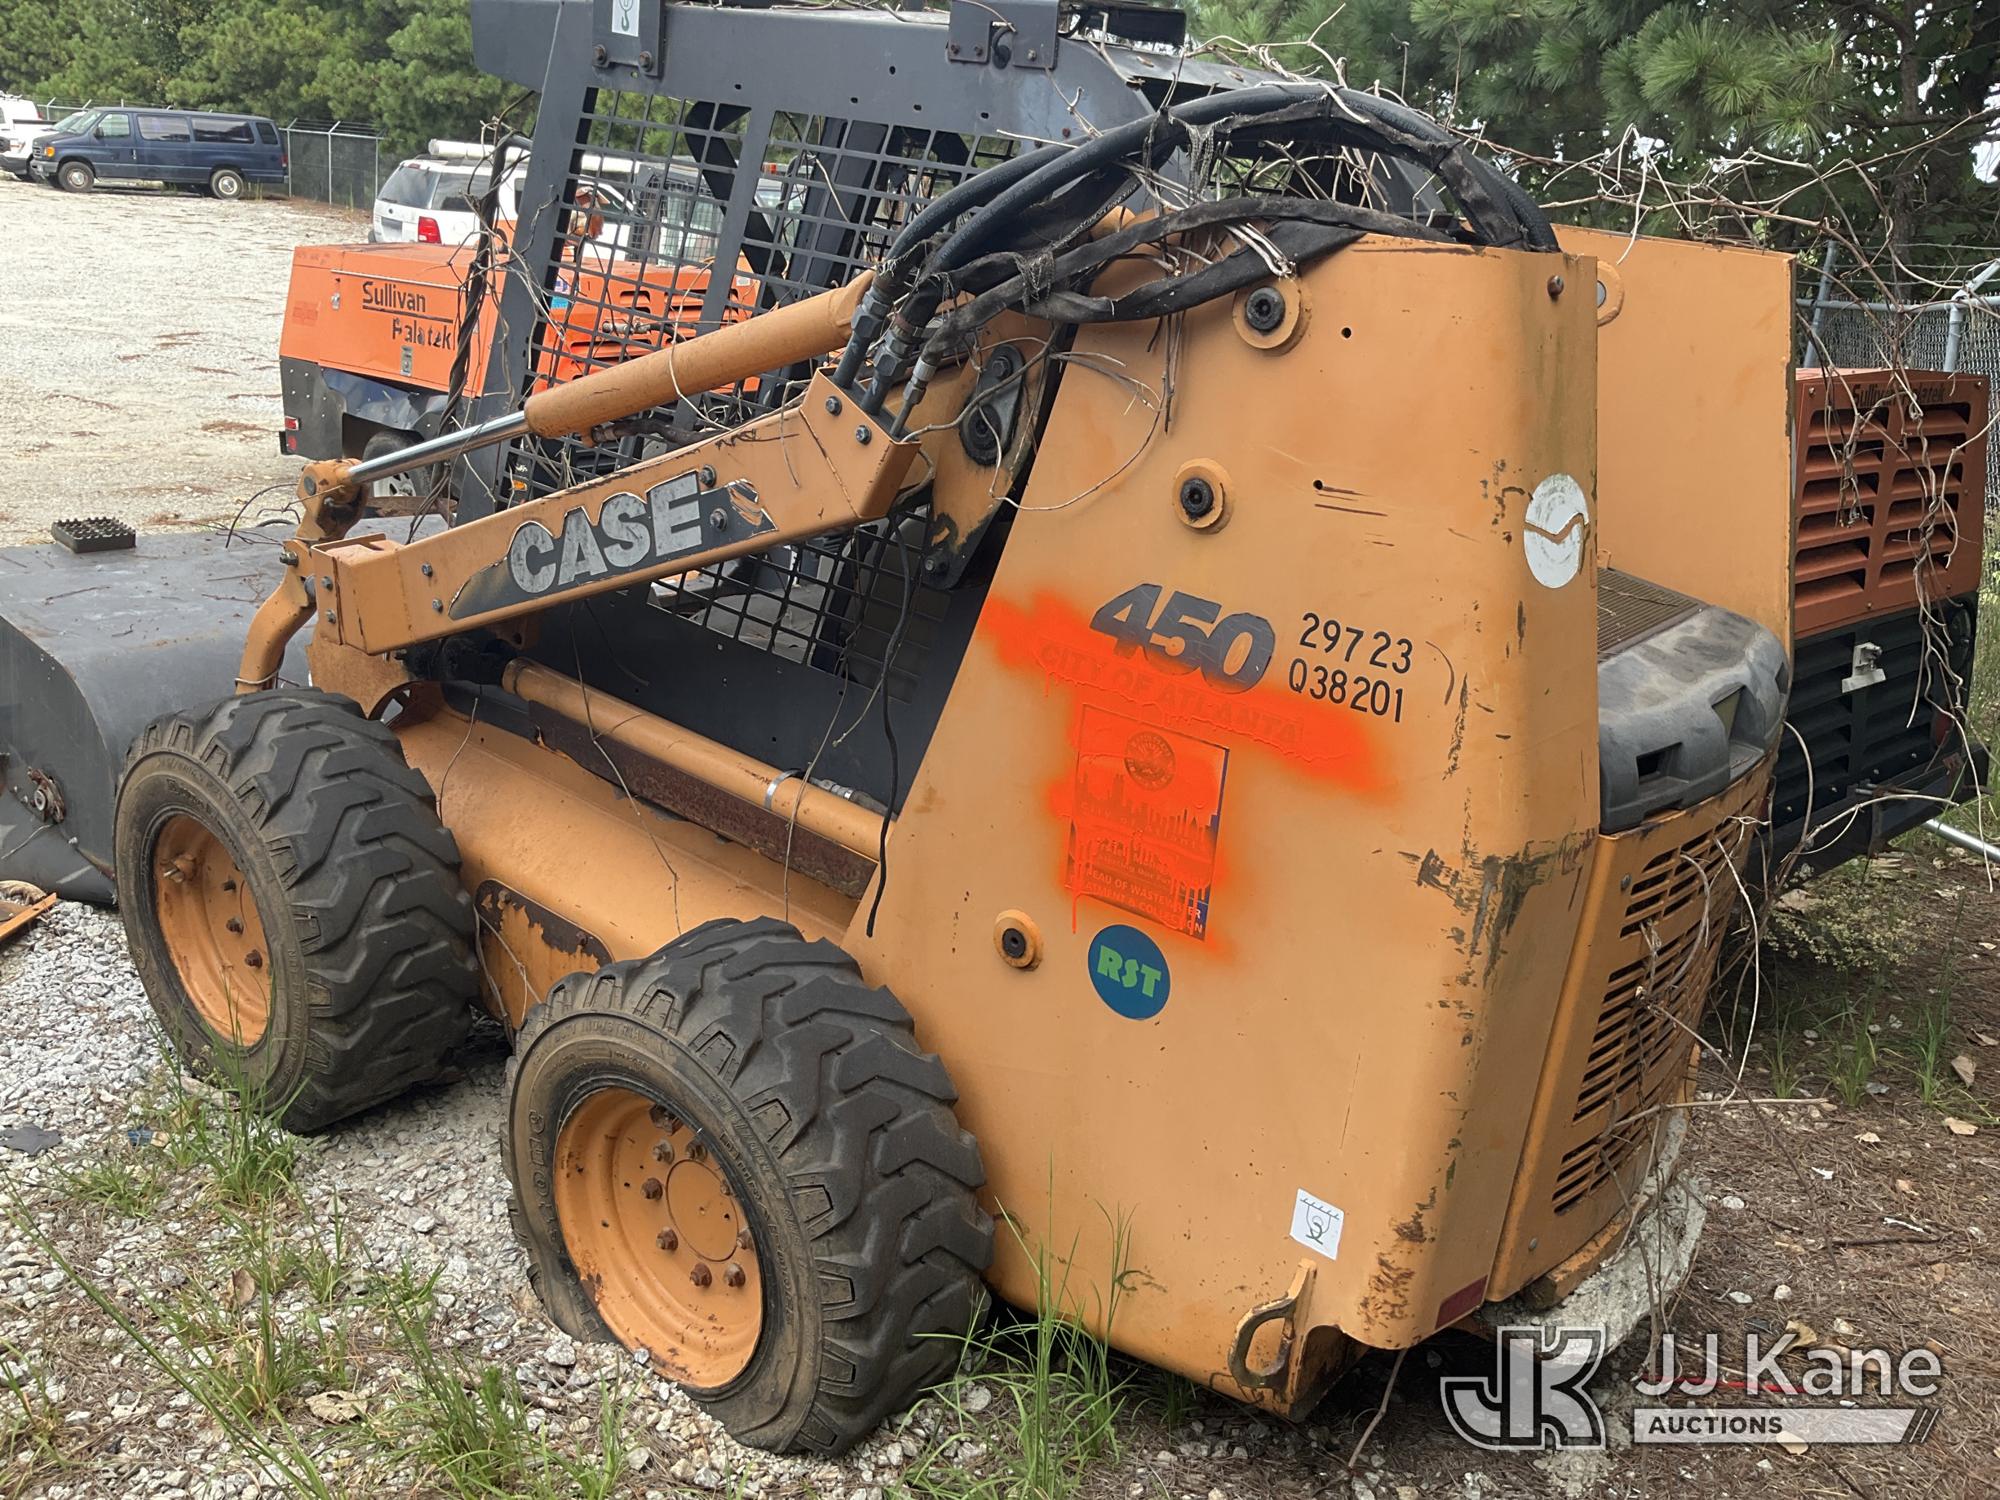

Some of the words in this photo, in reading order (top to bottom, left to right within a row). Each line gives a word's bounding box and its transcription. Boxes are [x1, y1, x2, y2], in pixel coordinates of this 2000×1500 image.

[361, 281, 427, 313] Sullivan
[508, 470, 703, 594] CASE
[1090, 583, 1275, 695] 450
[1299, 612, 1413, 674] 29723
[1290, 658, 1403, 723] Q38201
[1097, 944, 1162, 998] RST
